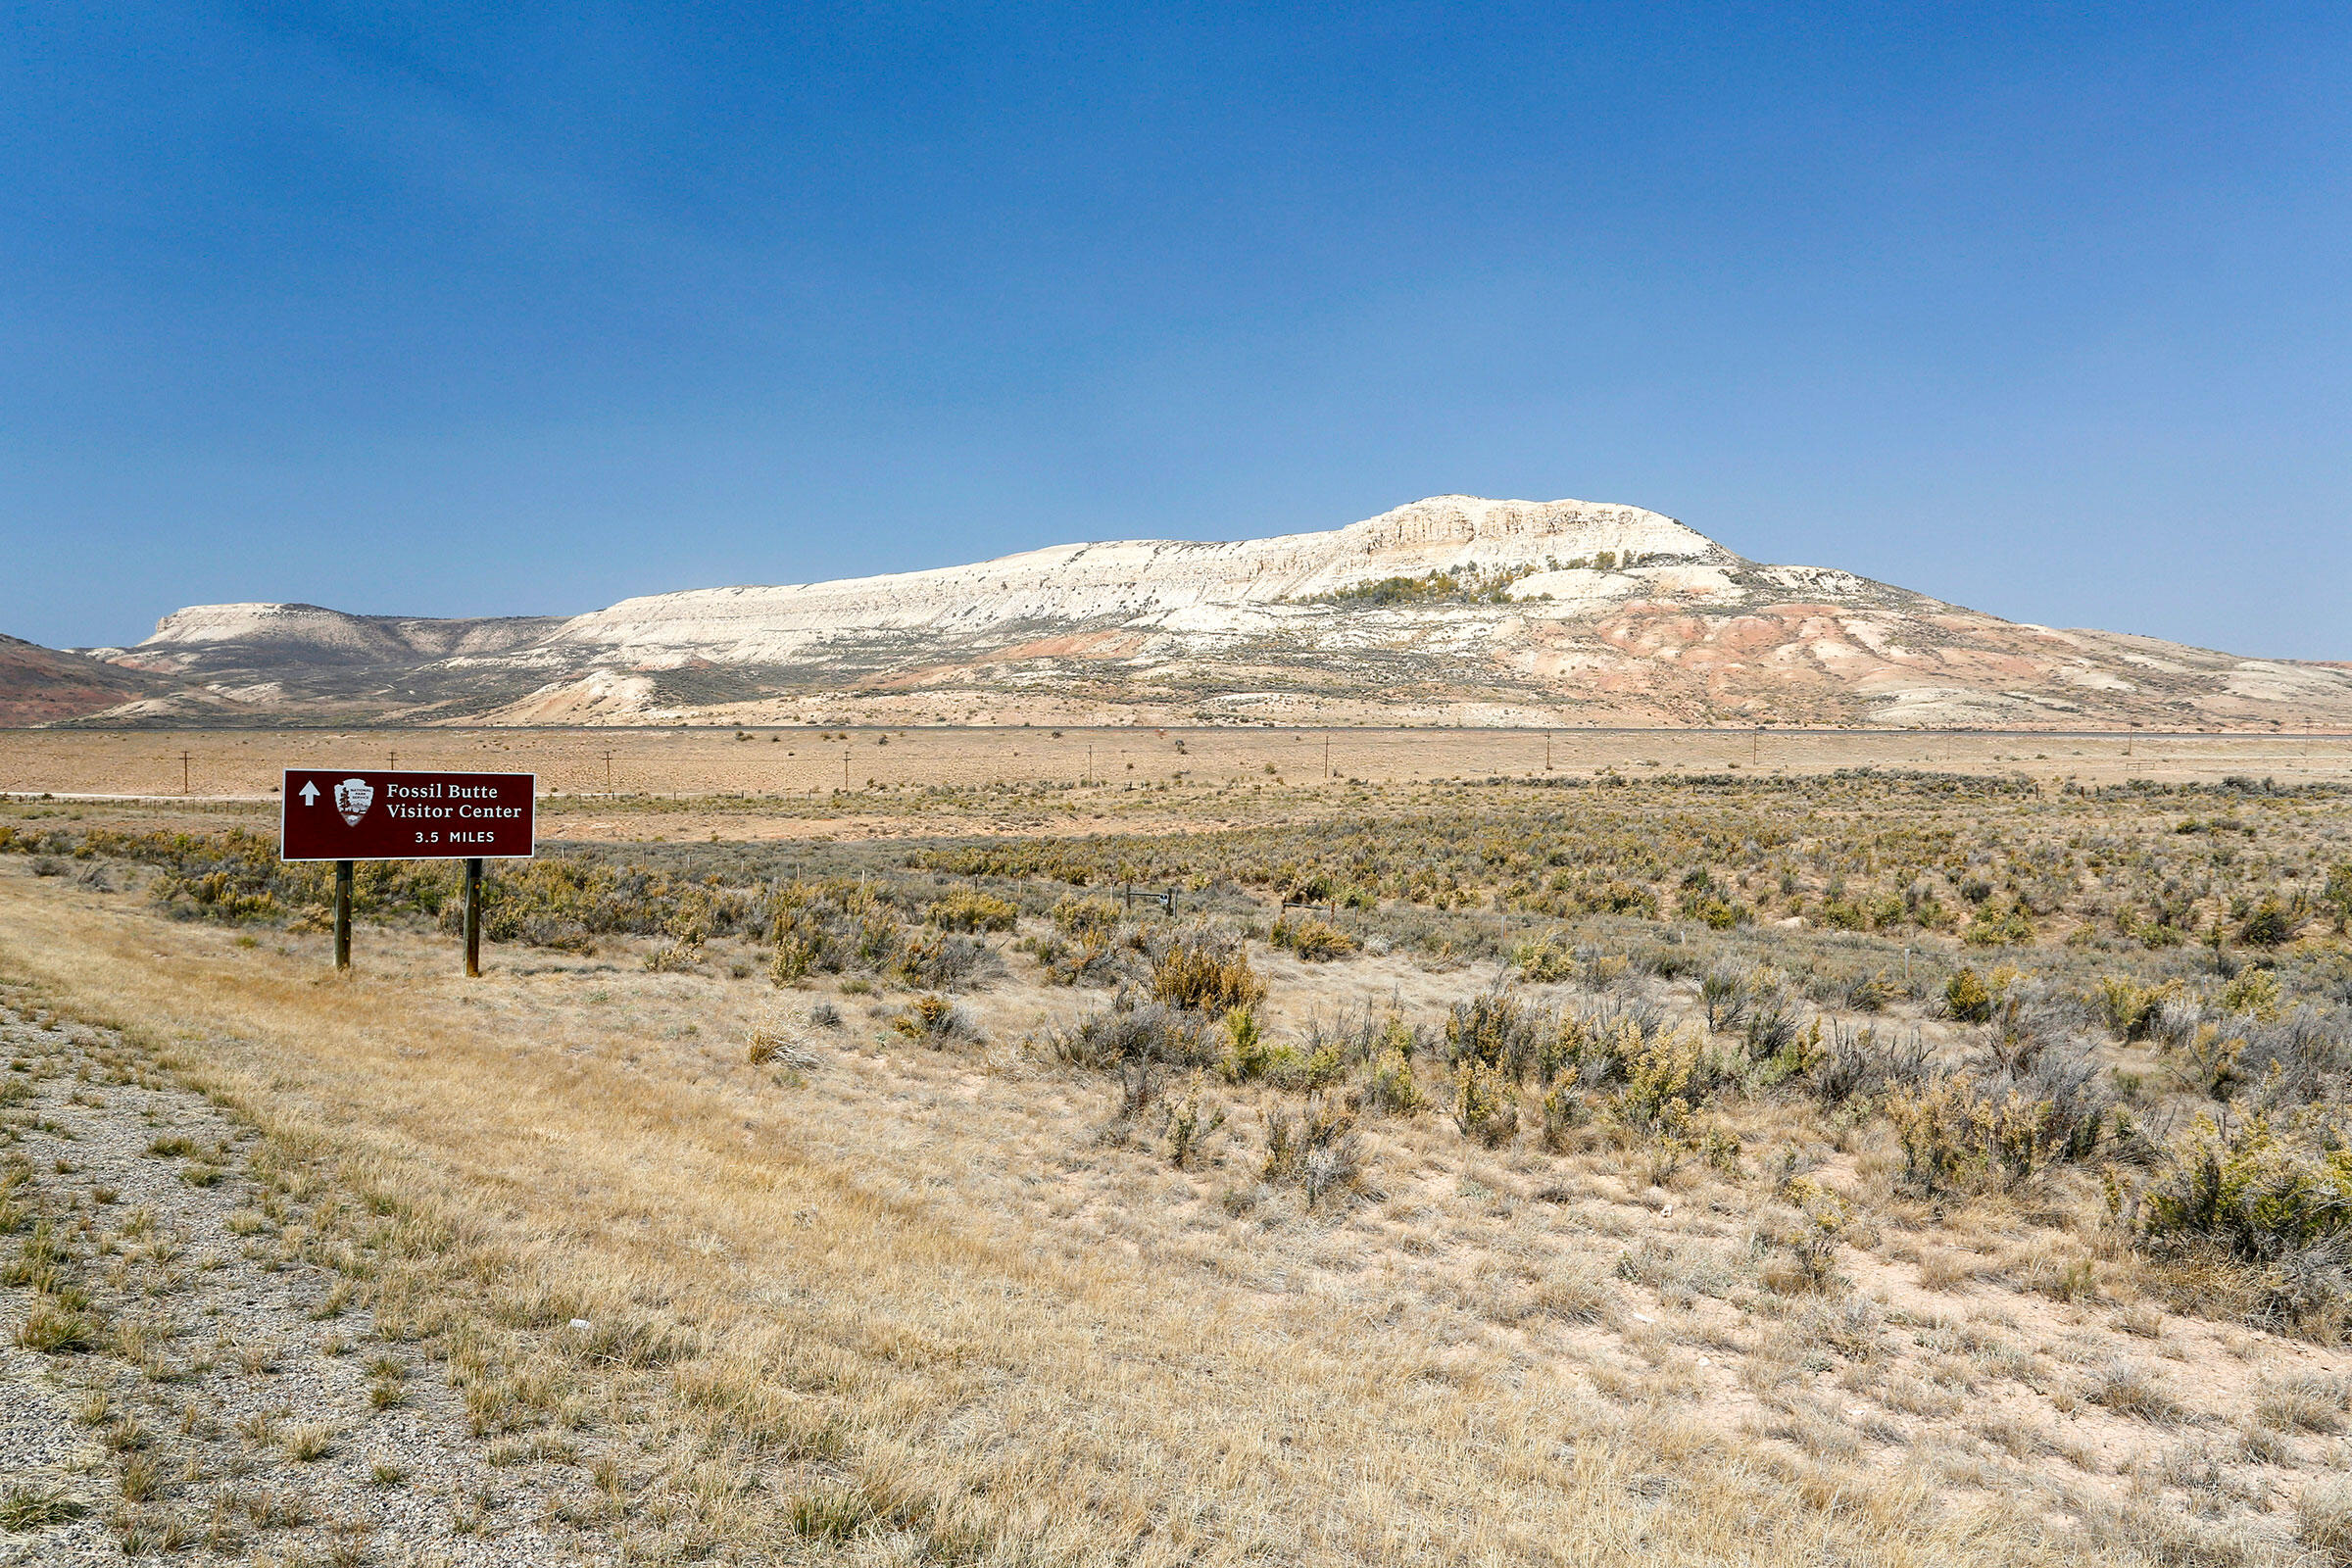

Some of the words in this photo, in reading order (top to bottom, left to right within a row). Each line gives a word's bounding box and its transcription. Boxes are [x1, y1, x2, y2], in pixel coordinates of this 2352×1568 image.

[386, 783, 443, 798] Fossil
[448, 785, 498, 799] Butte
[386, 804, 454, 818] Visitor
[459, 805, 522, 818] Center
[415, 831, 439, 843] 3.5
[449, 831, 495, 843] MILES
